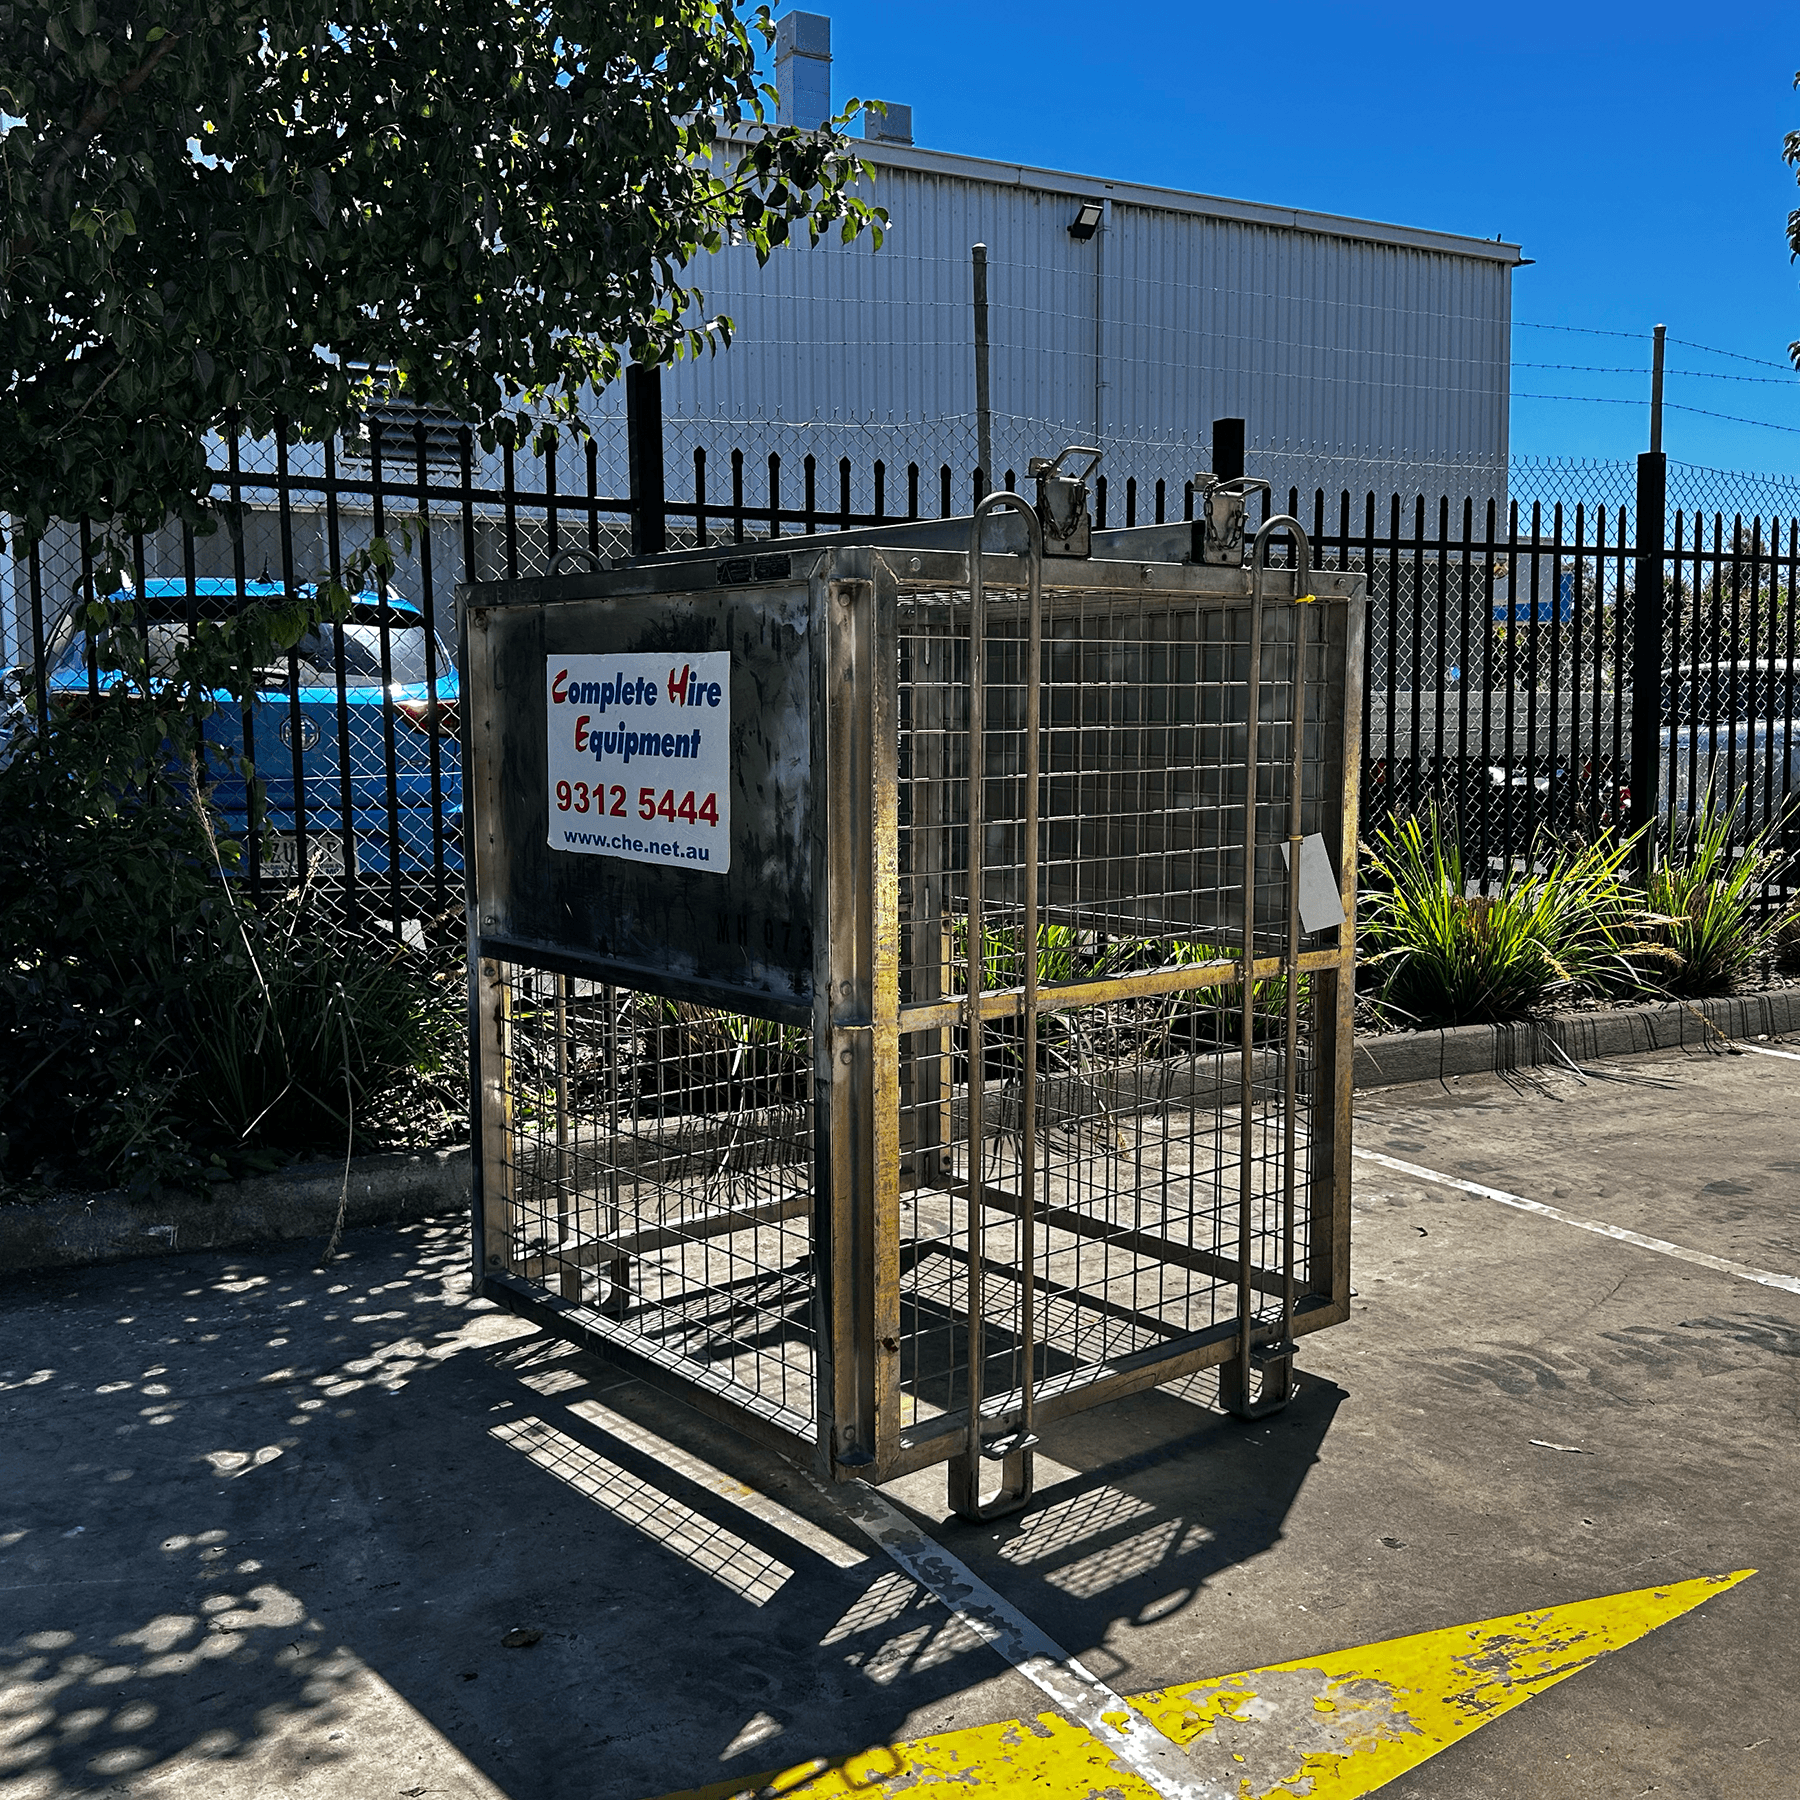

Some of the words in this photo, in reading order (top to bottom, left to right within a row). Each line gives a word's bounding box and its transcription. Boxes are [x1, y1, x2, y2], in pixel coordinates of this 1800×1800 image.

[551, 668, 658, 714] Complete
[667, 663, 722, 708] Hire
[574, 715, 701, 764] Equipment
[555, 780, 627, 818] 9312
[638, 787, 719, 828] 5444
[563, 830, 710, 861] www.che.net.au
